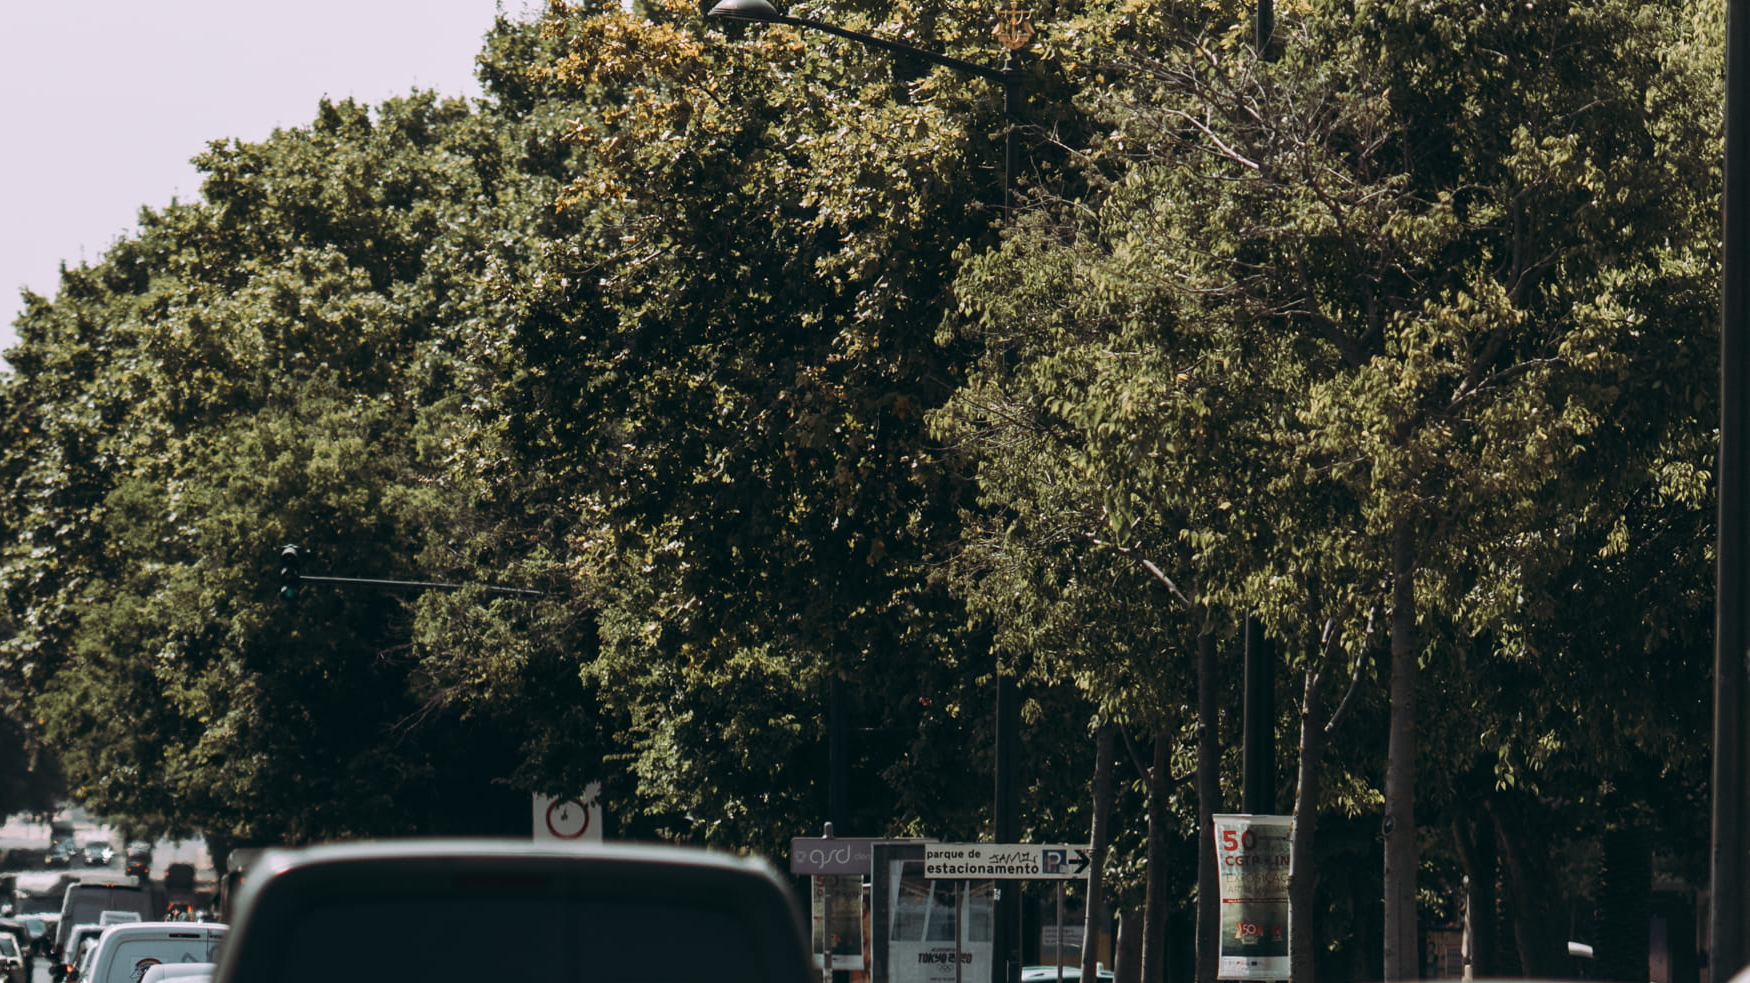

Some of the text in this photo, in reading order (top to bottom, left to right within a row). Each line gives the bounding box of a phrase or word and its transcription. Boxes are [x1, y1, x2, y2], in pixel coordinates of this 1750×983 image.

[1223, 830, 1257, 852] 50
[926, 849, 981, 860] parque de
[927, 862, 1039, 875] estacionamento
[918, 952, 947, 964] TOKYO
